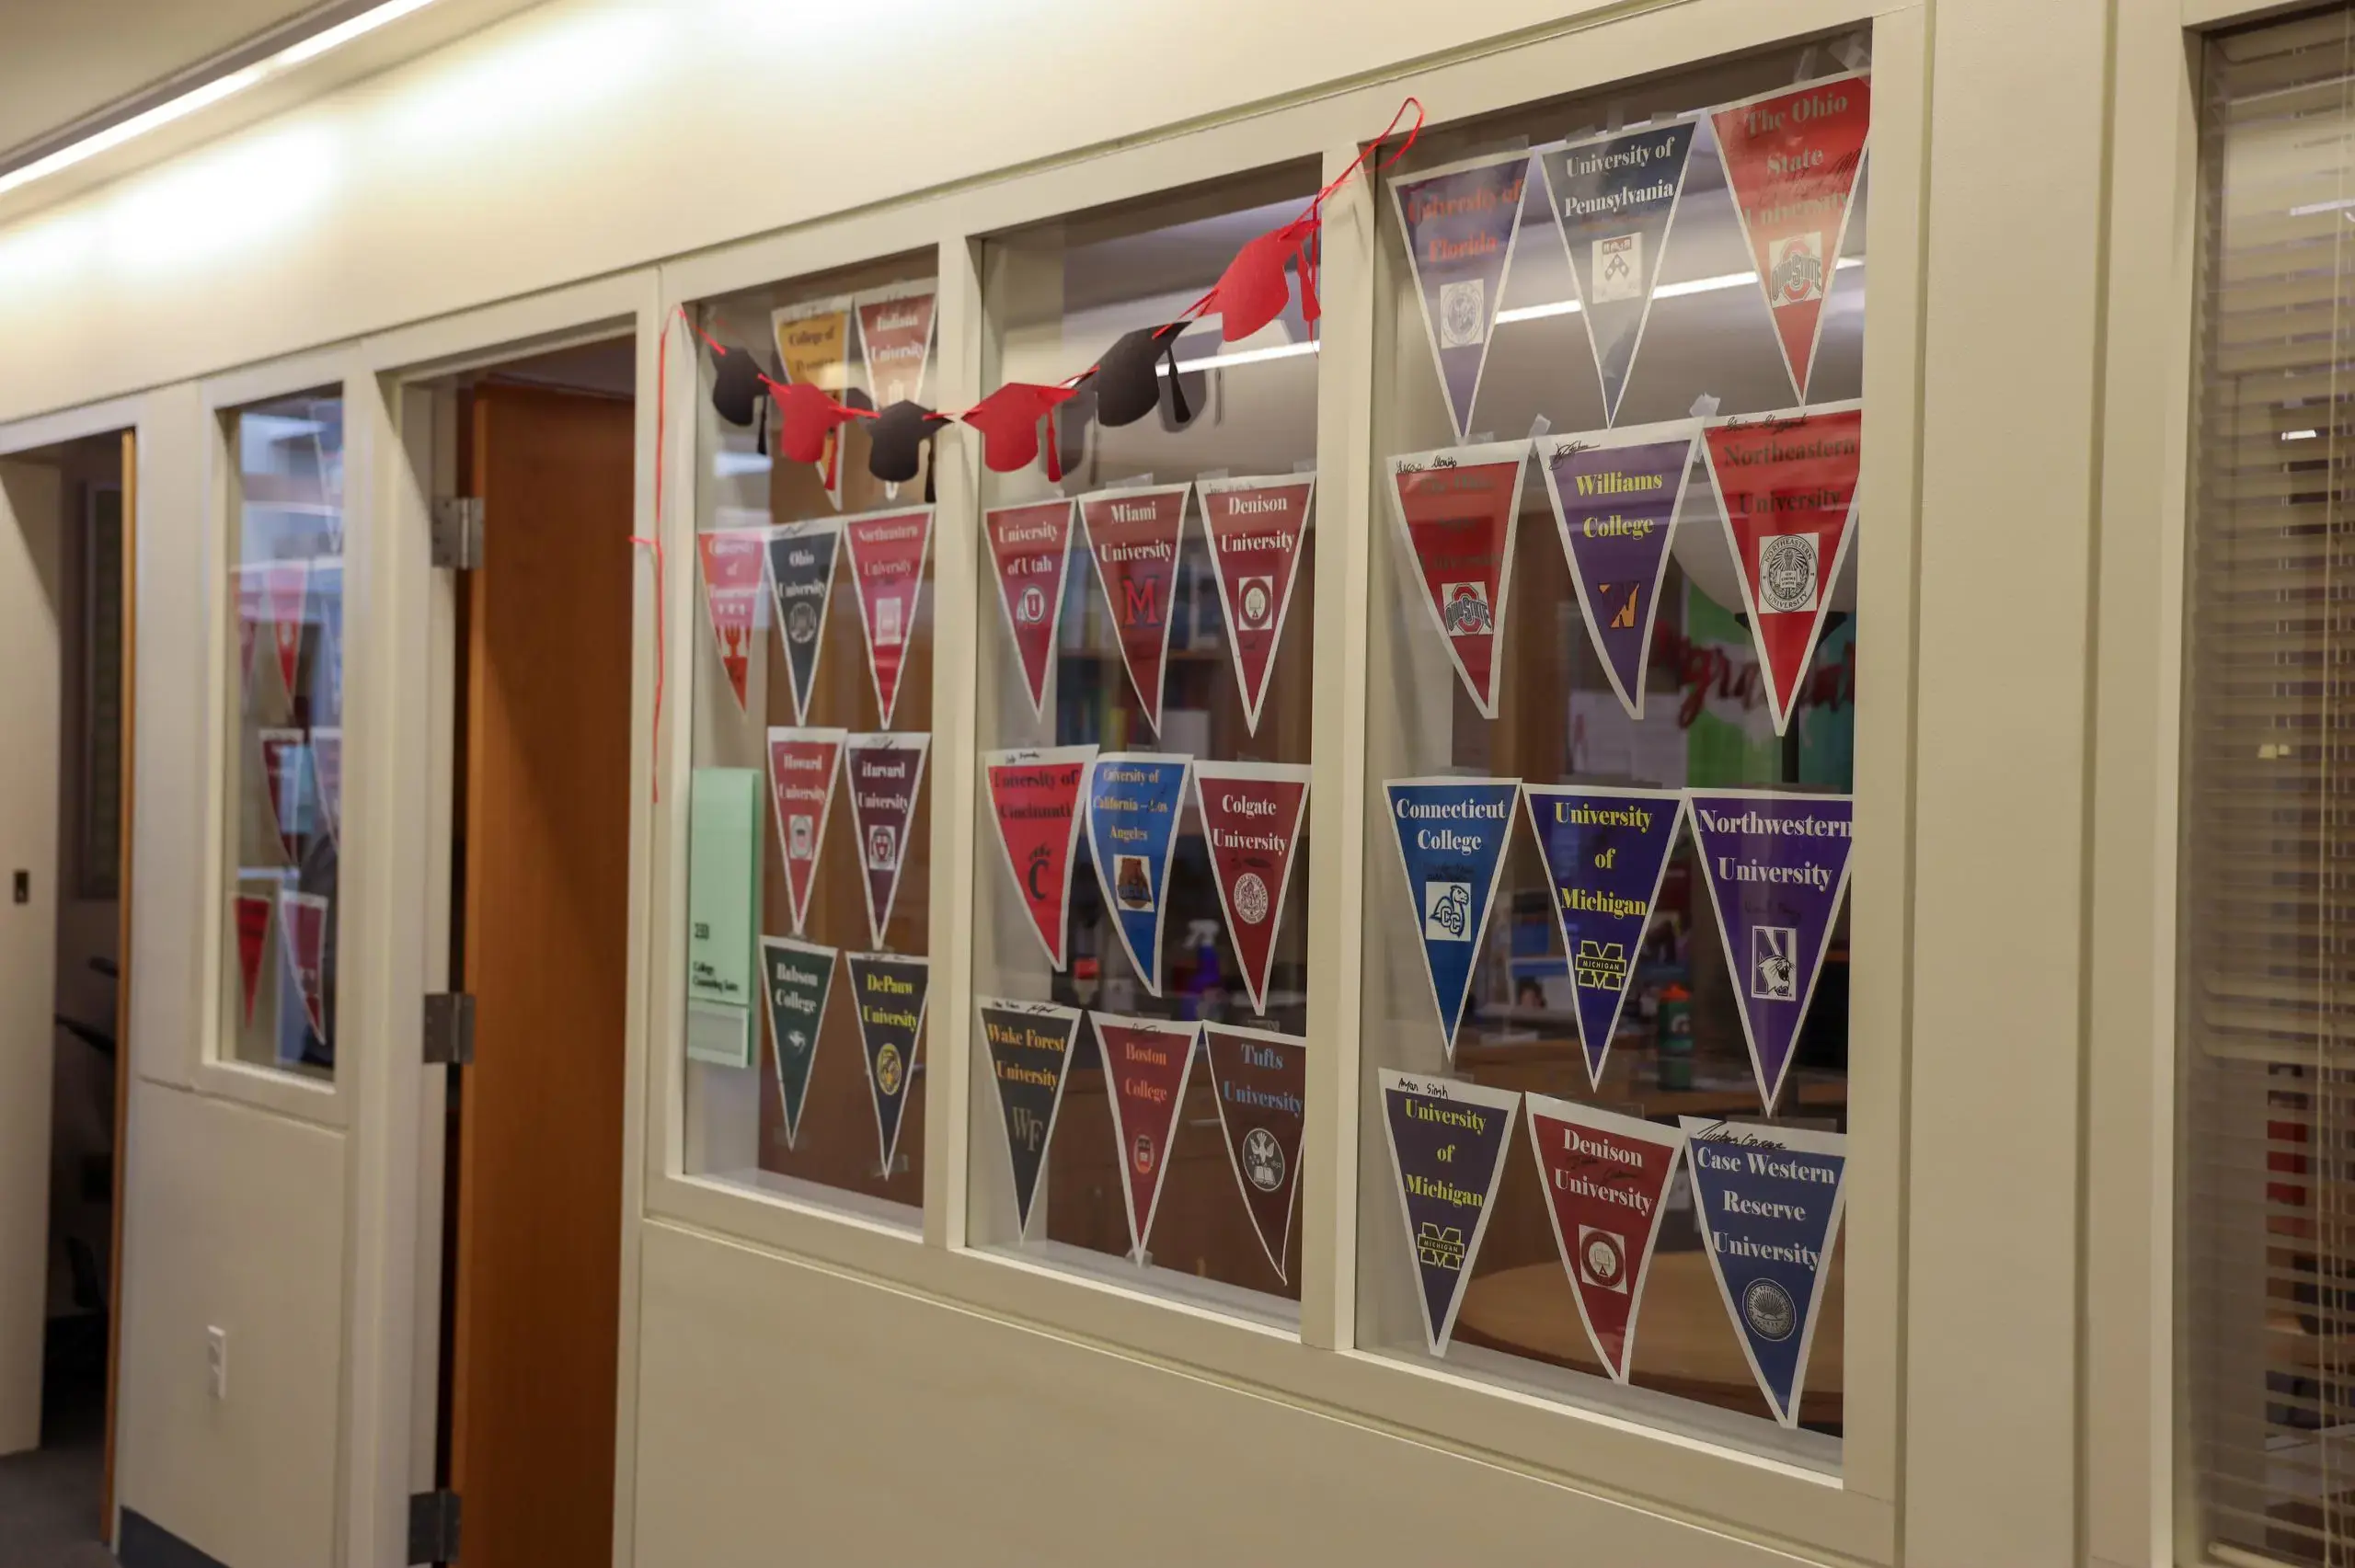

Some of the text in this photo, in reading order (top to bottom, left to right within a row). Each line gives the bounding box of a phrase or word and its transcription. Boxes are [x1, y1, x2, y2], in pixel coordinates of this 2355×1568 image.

[1792, 93, 1847, 122] Ohio
[1567, 136, 1675, 178] University of
[1767, 148, 1824, 176] State
[1564, 179, 1675, 217] Pennsylvania
[1429, 230, 1498, 263] Florida
[1723, 436, 1856, 467] Northeastern
[1575, 471, 1662, 497] Williams
[1110, 500, 1157, 524] Miami
[1229, 495, 1288, 515] Denison
[1739, 487, 1841, 515] University
[999, 521, 1058, 544] University
[1583, 515, 1655, 540] College
[1099, 539, 1173, 563] University
[1221, 530, 1295, 554] University
[1768, 590, 1808, 609] UNIVERSITY
[1222, 794, 1278, 819] Colgate
[1396, 797, 1507, 819] Connecticut
[1555, 802, 1653, 834] University
[1109, 825, 1148, 844] Angeles
[1698, 810, 1853, 838] Northwestern
[1212, 829, 1288, 858] University
[1417, 829, 1482, 855] College
[1594, 848, 1616, 869] of
[1717, 857, 1833, 892] University
[1560, 887, 1647, 920] Michigan
[1581, 958, 1621, 971] MICHIGAN
[867, 974, 914, 994] DePauw
[775, 989, 817, 1015] College
[862, 1005, 917, 1032] University
[987, 1023, 1066, 1052] Wake Forest
[1125, 1043, 1167, 1066] Boston
[1241, 1043, 1284, 1070] Tufts
[995, 1059, 1060, 1093] University
[1124, 1077, 1168, 1104] College
[1223, 1080, 1304, 1118] University
[1012, 1106, 1044, 1151] WF
[1405, 1098, 1488, 1136] University
[1436, 1144, 1456, 1162] of
[1563, 1128, 1644, 1167] Denison
[1697, 1146, 1835, 1185] Case Western
[1405, 1174, 1485, 1207] Michigan
[1553, 1167, 1654, 1218] University
[1722, 1190, 1808, 1222] Reserve
[1423, 1240, 1460, 1253] MICHIGAN
[1712, 1230, 1821, 1272] University
